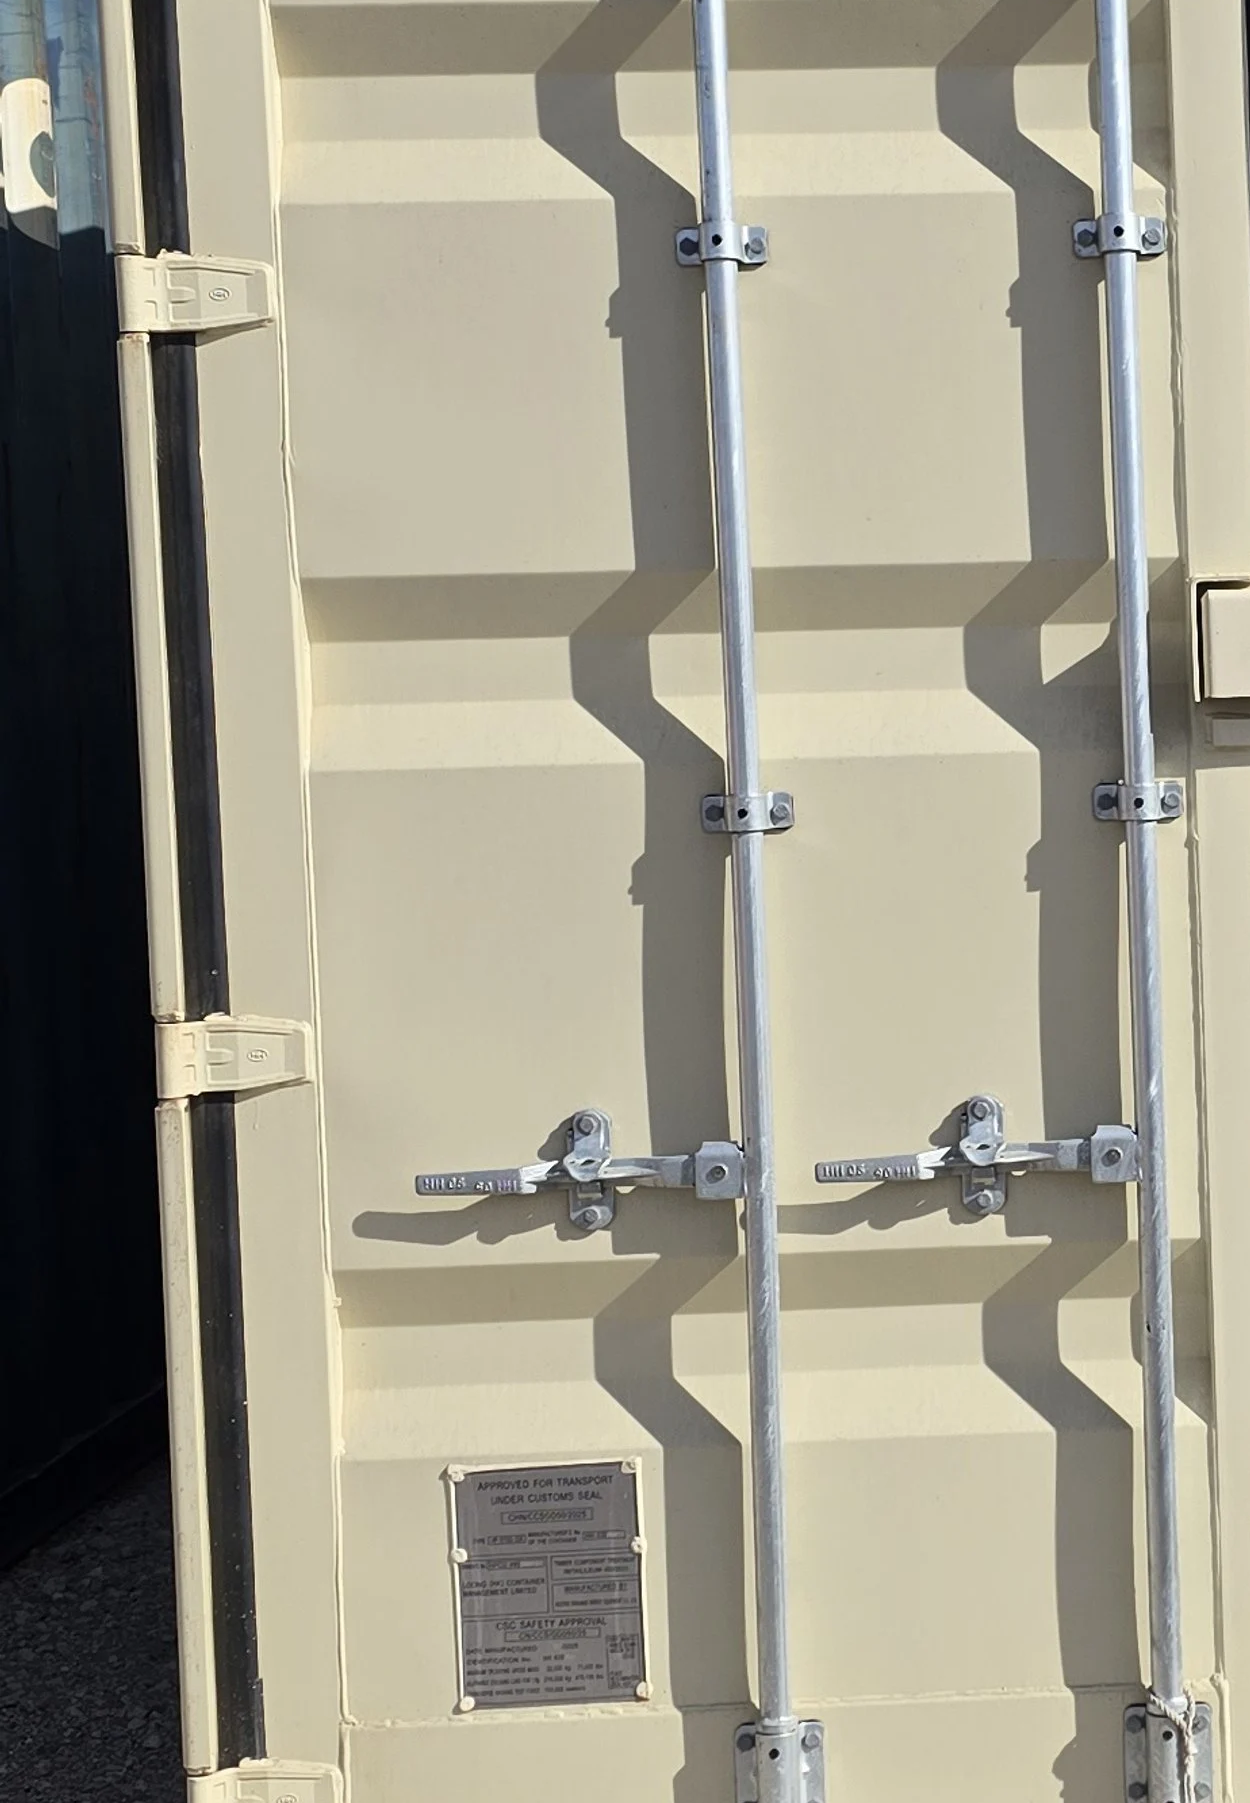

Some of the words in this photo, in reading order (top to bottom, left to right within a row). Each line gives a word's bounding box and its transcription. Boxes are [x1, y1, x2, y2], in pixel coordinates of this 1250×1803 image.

[533, 1479, 553, 1488] FOR
[557, 1475, 613, 1486] TRANSPORT
[490, 1495, 524, 1505] UNDER
[527, 1492, 574, 1503] CUSTOMS
[519, 1619, 556, 1630] SAFETY
